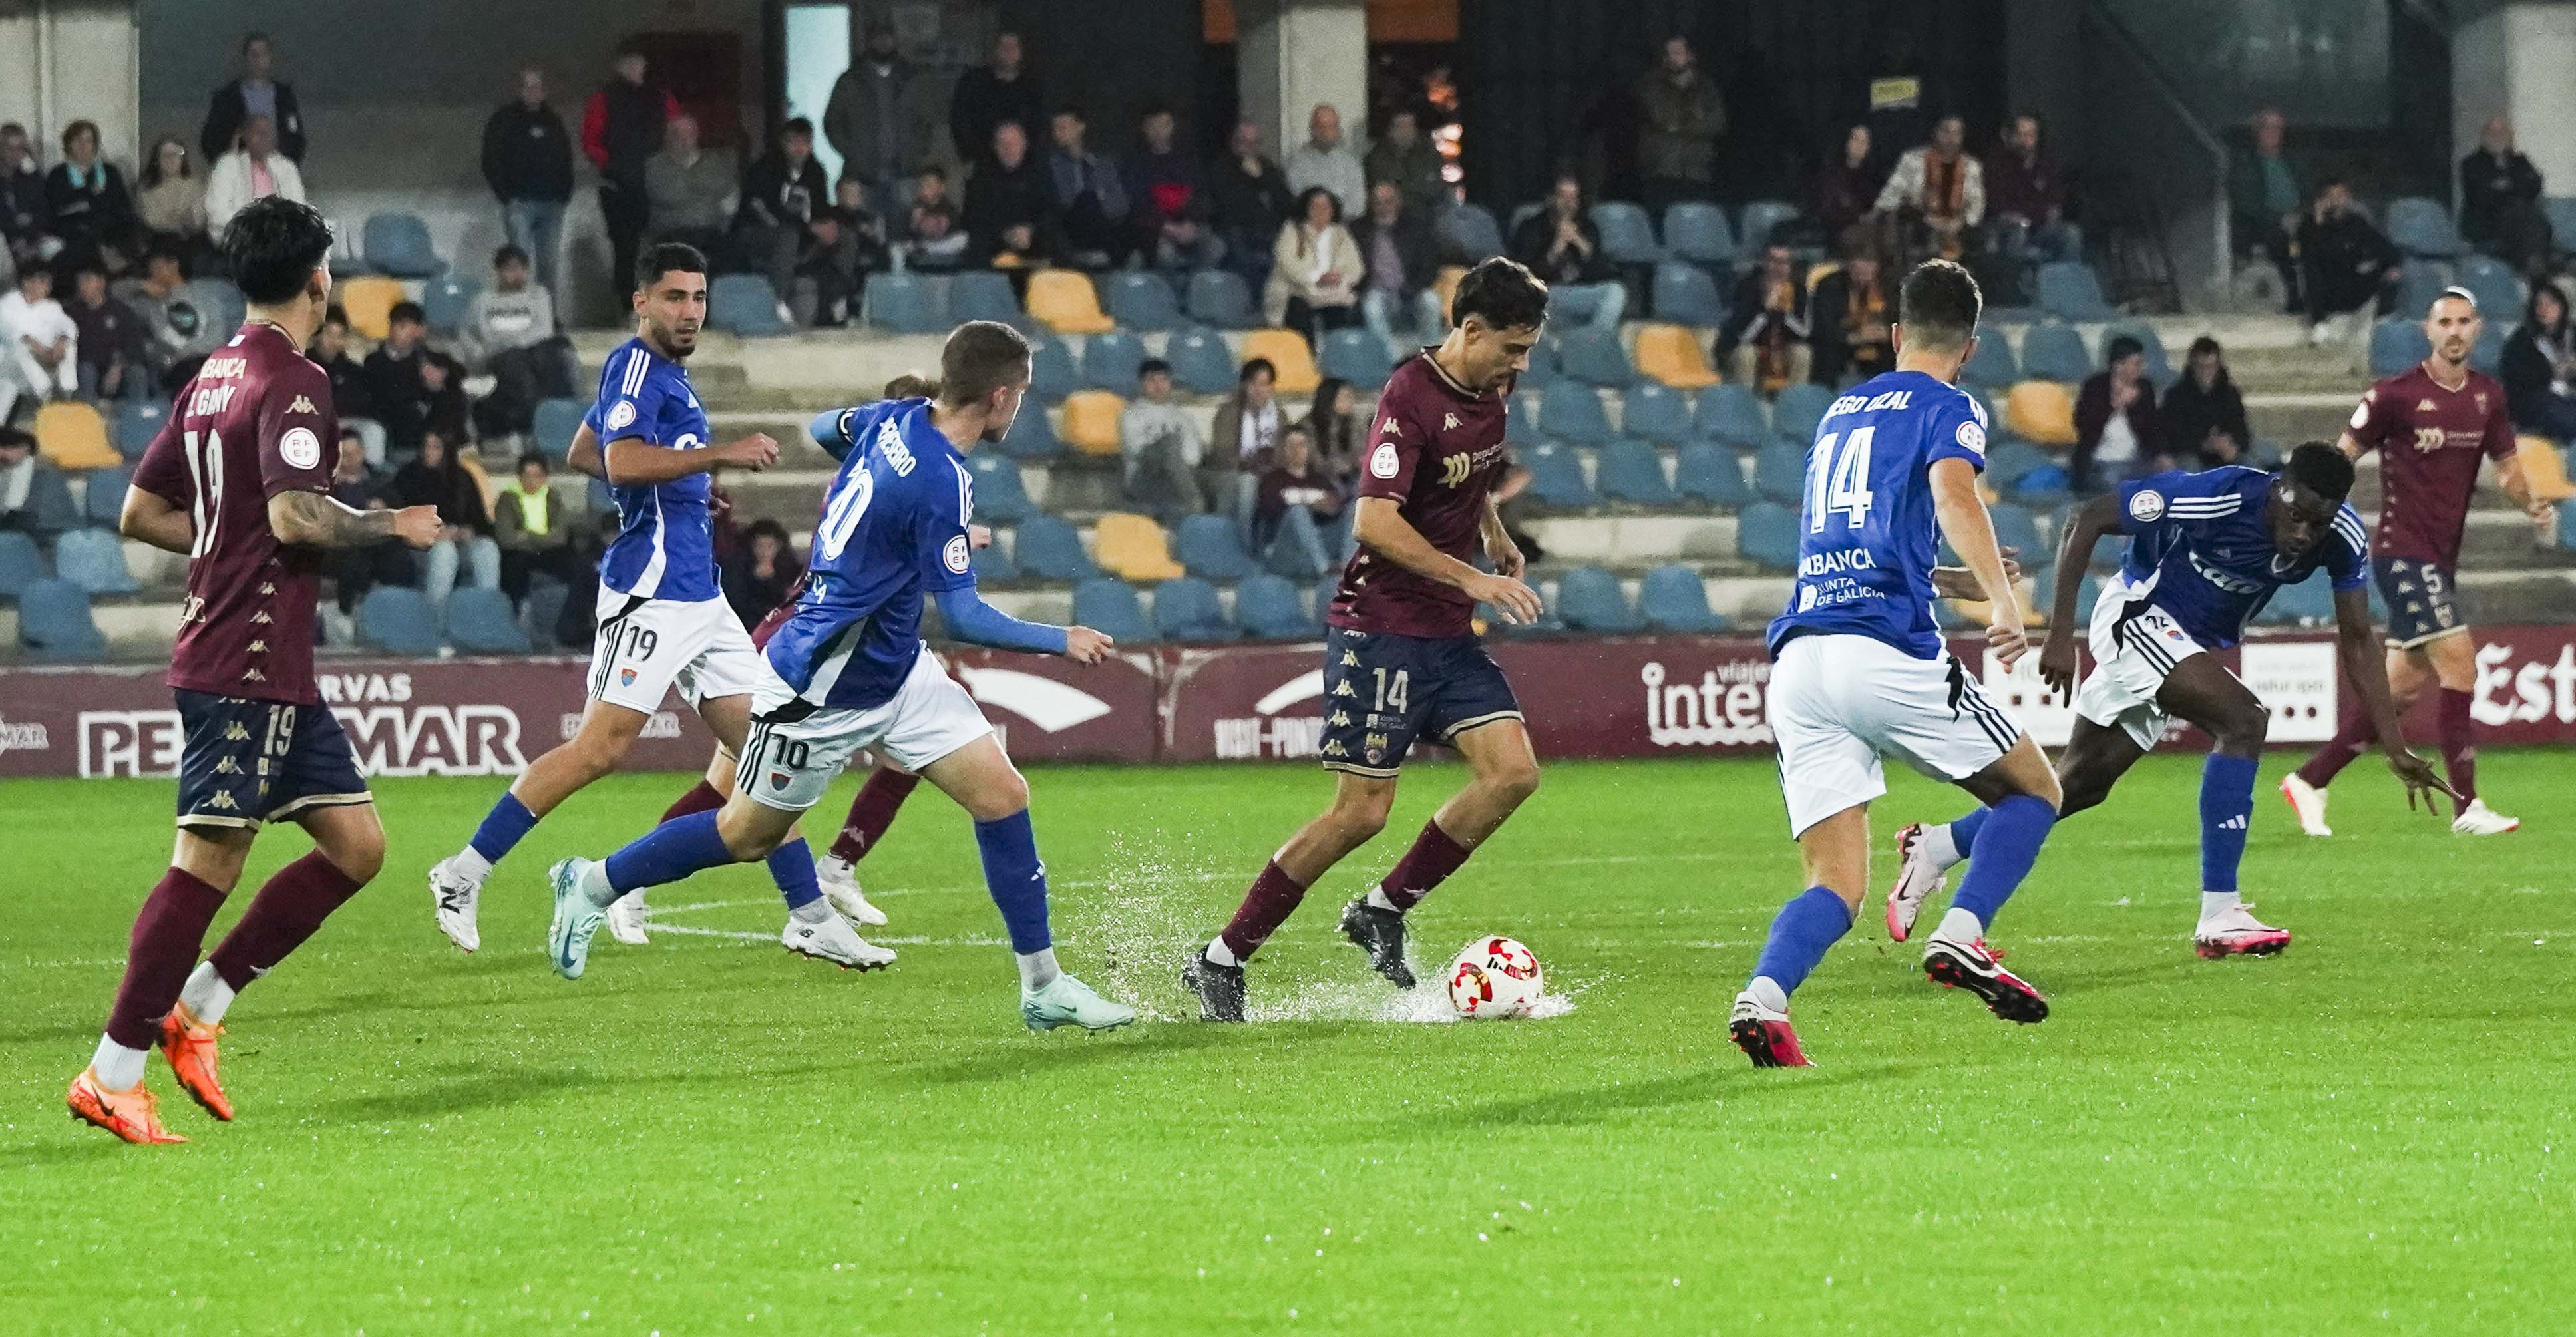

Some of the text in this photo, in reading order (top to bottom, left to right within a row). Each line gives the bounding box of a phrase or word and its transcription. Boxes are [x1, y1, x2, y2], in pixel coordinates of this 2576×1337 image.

[1863, 391, 1913, 413] UZAL
[183, 428, 224, 558] 19
[1809, 425, 1876, 534] 14
[1798, 548, 1877, 579] ABANCA
[2420, 564, 2443, 594] 5
[1817, 586, 1885, 606] DE GALICIA
[627, 626, 658, 662] 19
[1372, 668, 1408, 714] 14
[264, 705, 296, 757] 19
[769, 733, 809, 770] 10
